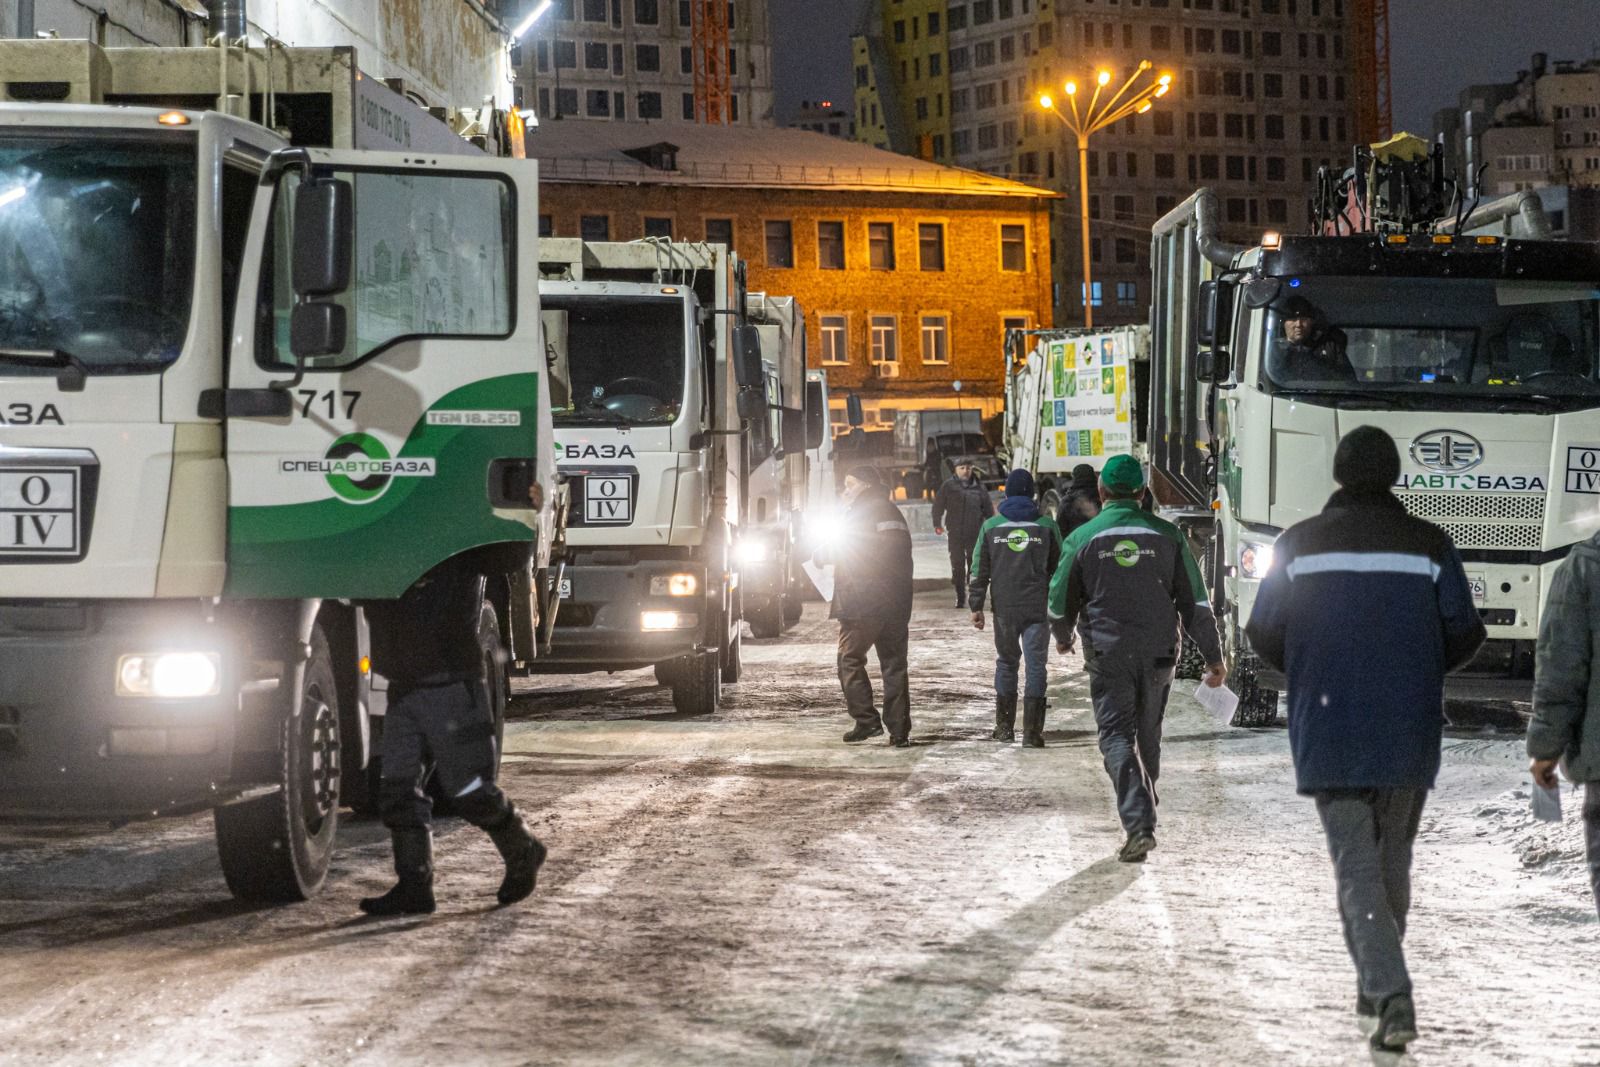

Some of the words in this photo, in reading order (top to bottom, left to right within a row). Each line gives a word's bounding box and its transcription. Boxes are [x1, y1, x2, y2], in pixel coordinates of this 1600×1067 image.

[0, 403, 65, 426] ЗА
[299, 389, 362, 420] 717
[282, 460, 432, 474] СПЕЦАВТОБАЗА
[1574, 472, 1599, 490] IV
[595, 501, 621, 518] IV
[12, 514, 59, 545] IV
